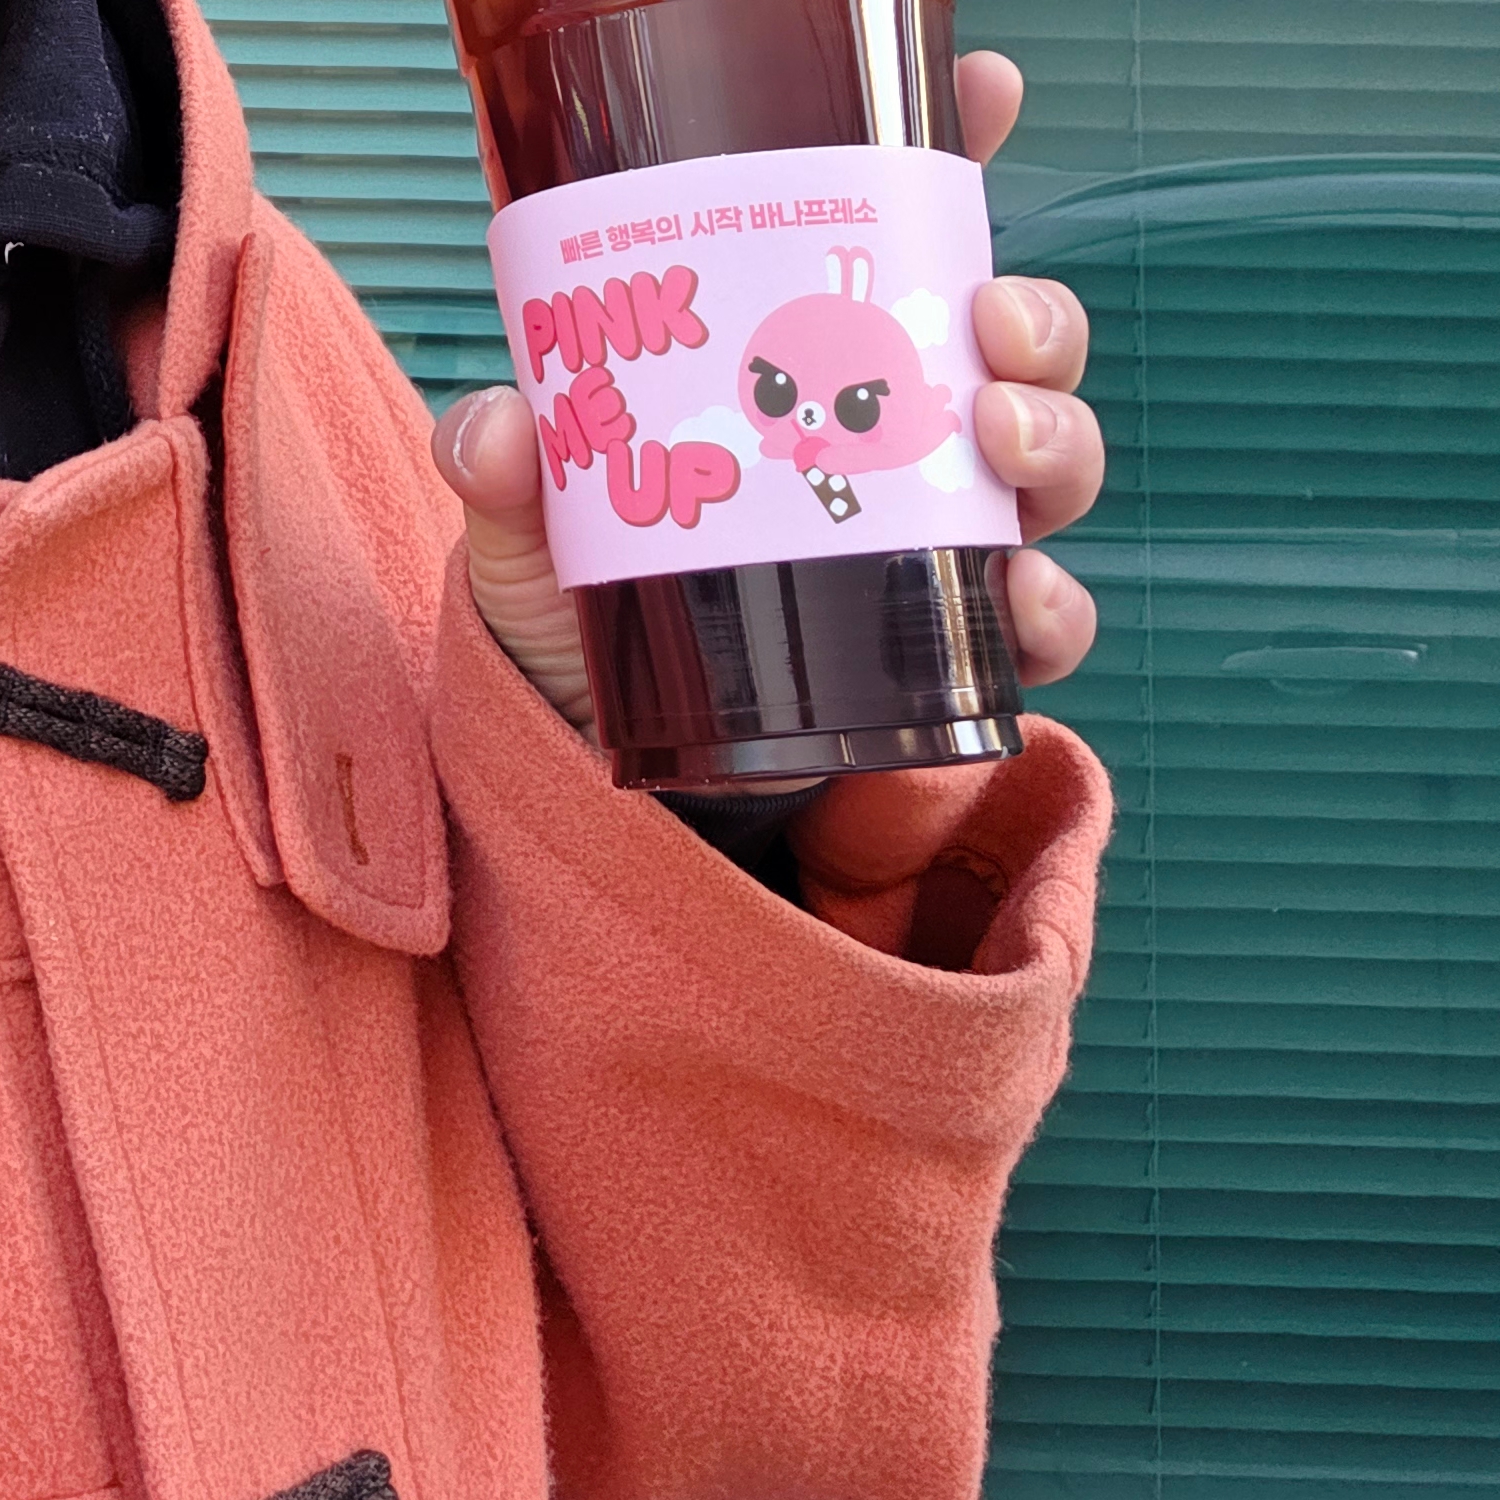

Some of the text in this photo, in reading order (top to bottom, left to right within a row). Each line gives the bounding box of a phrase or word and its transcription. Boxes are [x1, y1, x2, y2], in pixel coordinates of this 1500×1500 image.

[560, 197, 879, 265] 빠른 행복의 시작 바나프레소
[522, 264, 710, 384] PINK
[538, 366, 637, 492] ME
[606, 437, 742, 530] UP
